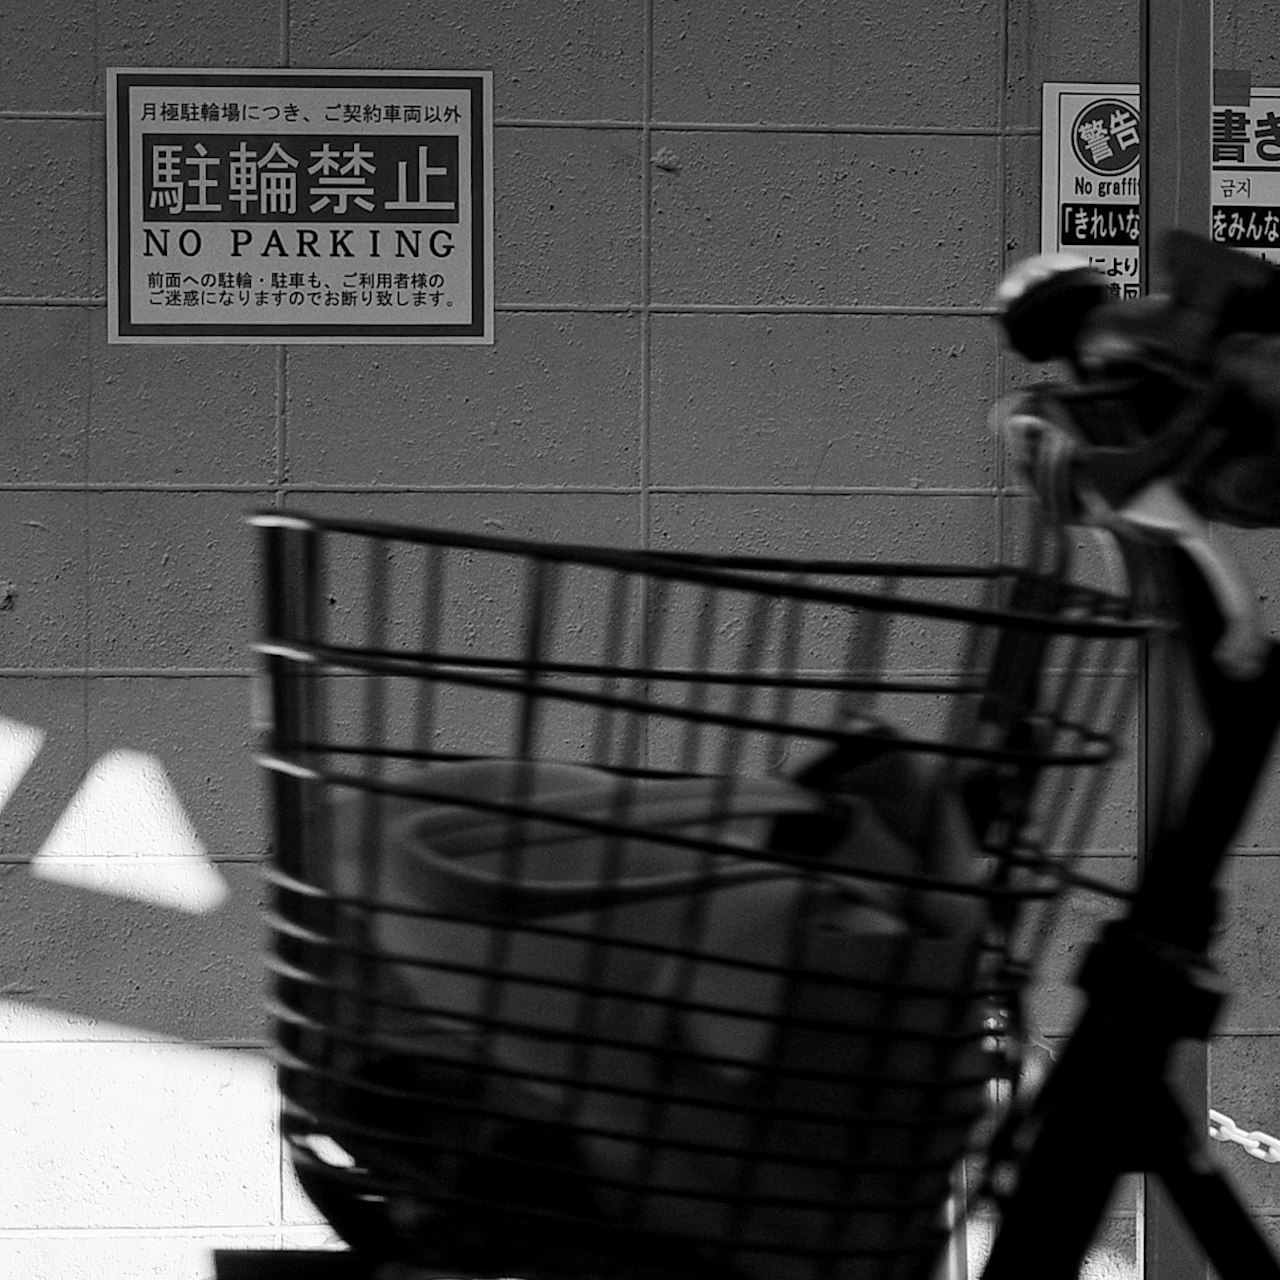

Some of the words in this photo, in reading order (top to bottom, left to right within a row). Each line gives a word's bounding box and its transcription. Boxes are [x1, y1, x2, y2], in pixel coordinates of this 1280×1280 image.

[1077, 109, 1140, 164] 警告
[149, 141, 455, 215] 駐輪禁止
[1075, 177, 1093, 195] No
[1099, 177, 1140, 197] graffi
[1220, 178, 1251, 199] 금지
[143, 229, 202, 257] NO
[231, 229, 455, 258] PARKING
